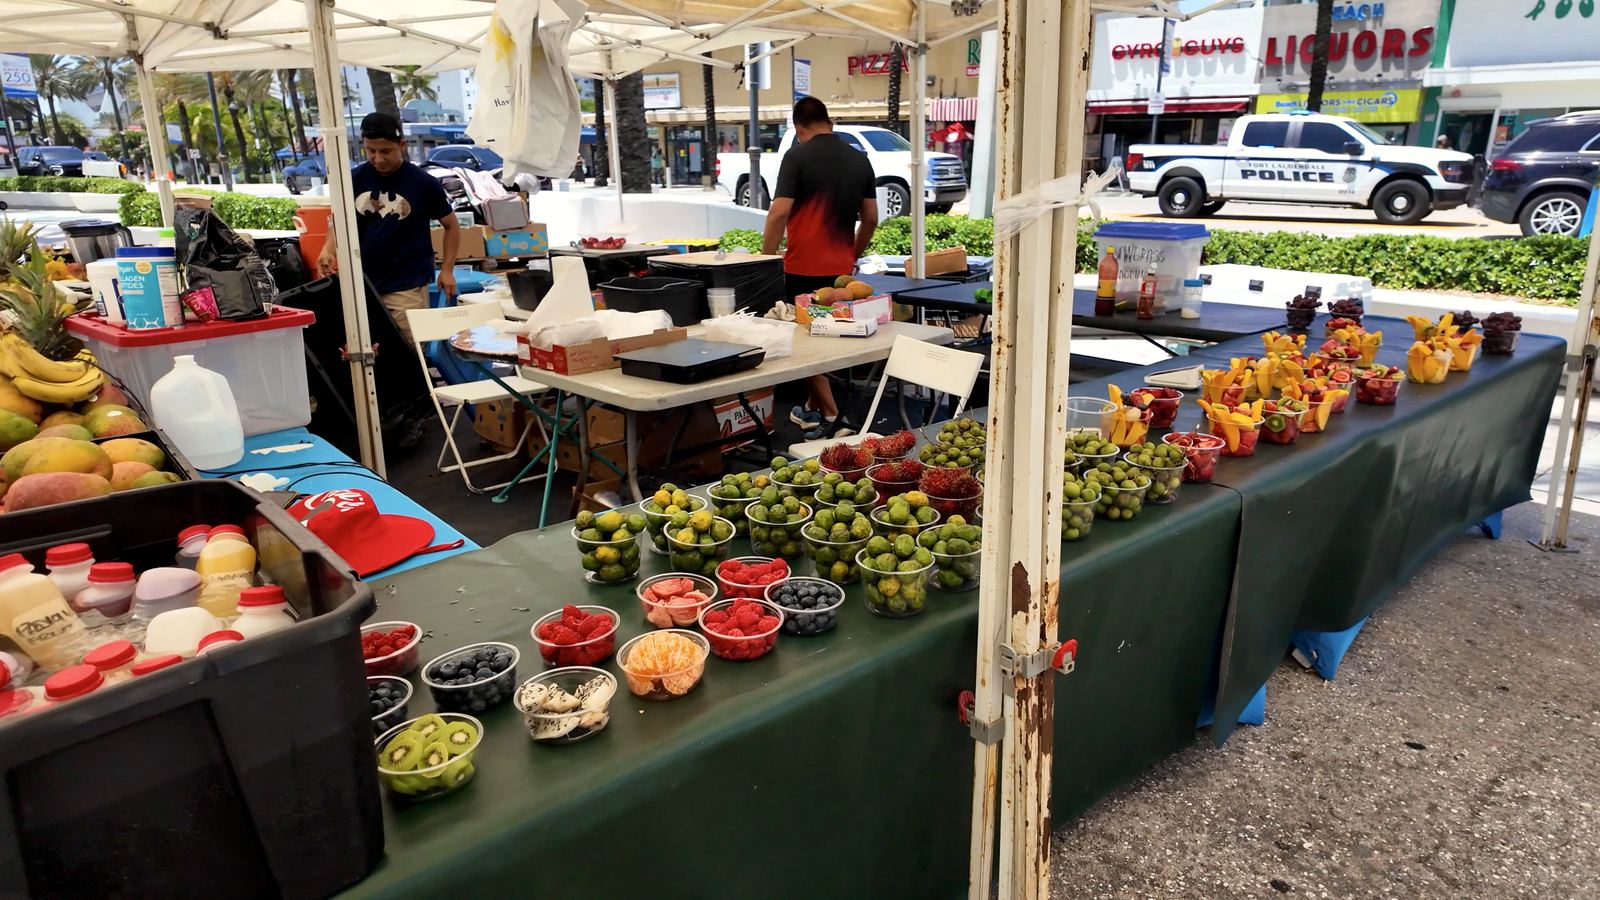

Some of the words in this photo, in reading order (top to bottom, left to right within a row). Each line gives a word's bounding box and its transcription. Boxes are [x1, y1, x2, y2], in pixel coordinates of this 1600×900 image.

[1332, 3, 1384, 20] EACH
[968, 38, 981, 64] R
[1184, 37, 1245, 56] GUYS
[4, 72, 31, 83] 250
[494, 98, 510, 107] Hav
[1241, 170, 1335, 183] POLICE
